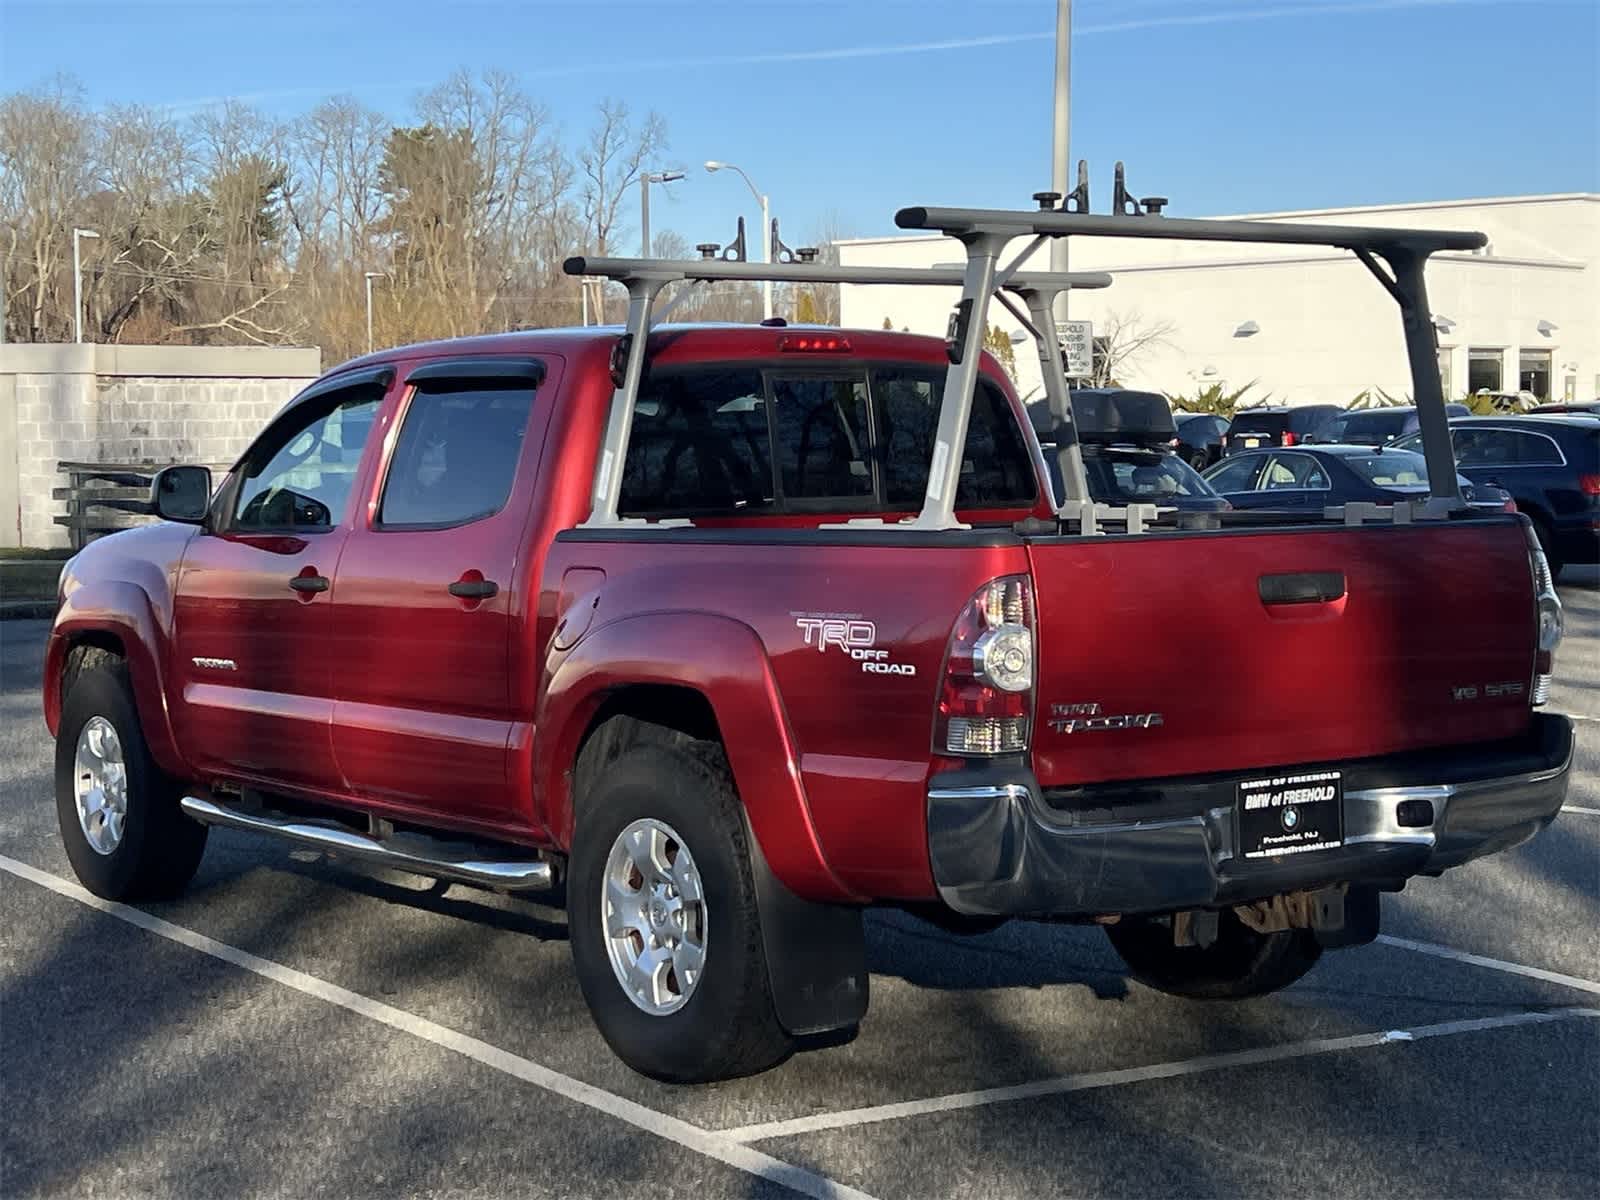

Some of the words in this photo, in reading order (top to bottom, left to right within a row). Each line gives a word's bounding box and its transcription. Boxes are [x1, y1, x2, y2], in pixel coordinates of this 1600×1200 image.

[796, 618, 876, 653] TRD
[850, 648, 889, 660] OFF
[862, 661, 916, 675] ROAD
[1271, 777, 1286, 786] OF
[1287, 771, 1341, 784] FREEHOLD
[1244, 792, 1272, 810] BMW
[1271, 791, 1282, 807] of
[1282, 785, 1336, 806] FREEHOLD
